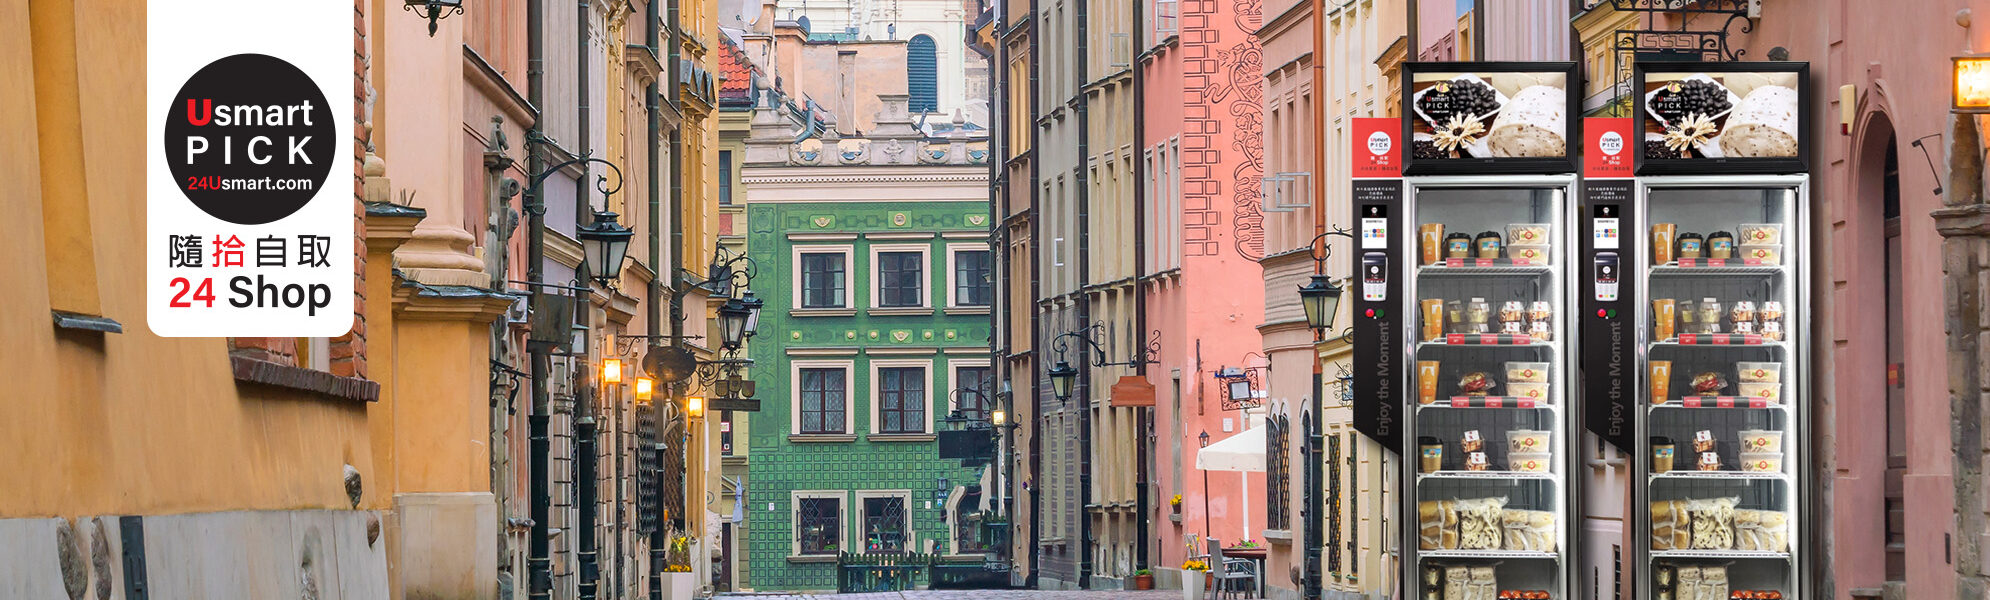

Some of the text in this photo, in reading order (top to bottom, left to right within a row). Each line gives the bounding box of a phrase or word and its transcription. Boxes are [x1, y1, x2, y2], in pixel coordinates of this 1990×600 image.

[1376, 321, 1392, 436] Enjoy the Moment
[1608, 321, 1624, 436] Enjoy the Moment
